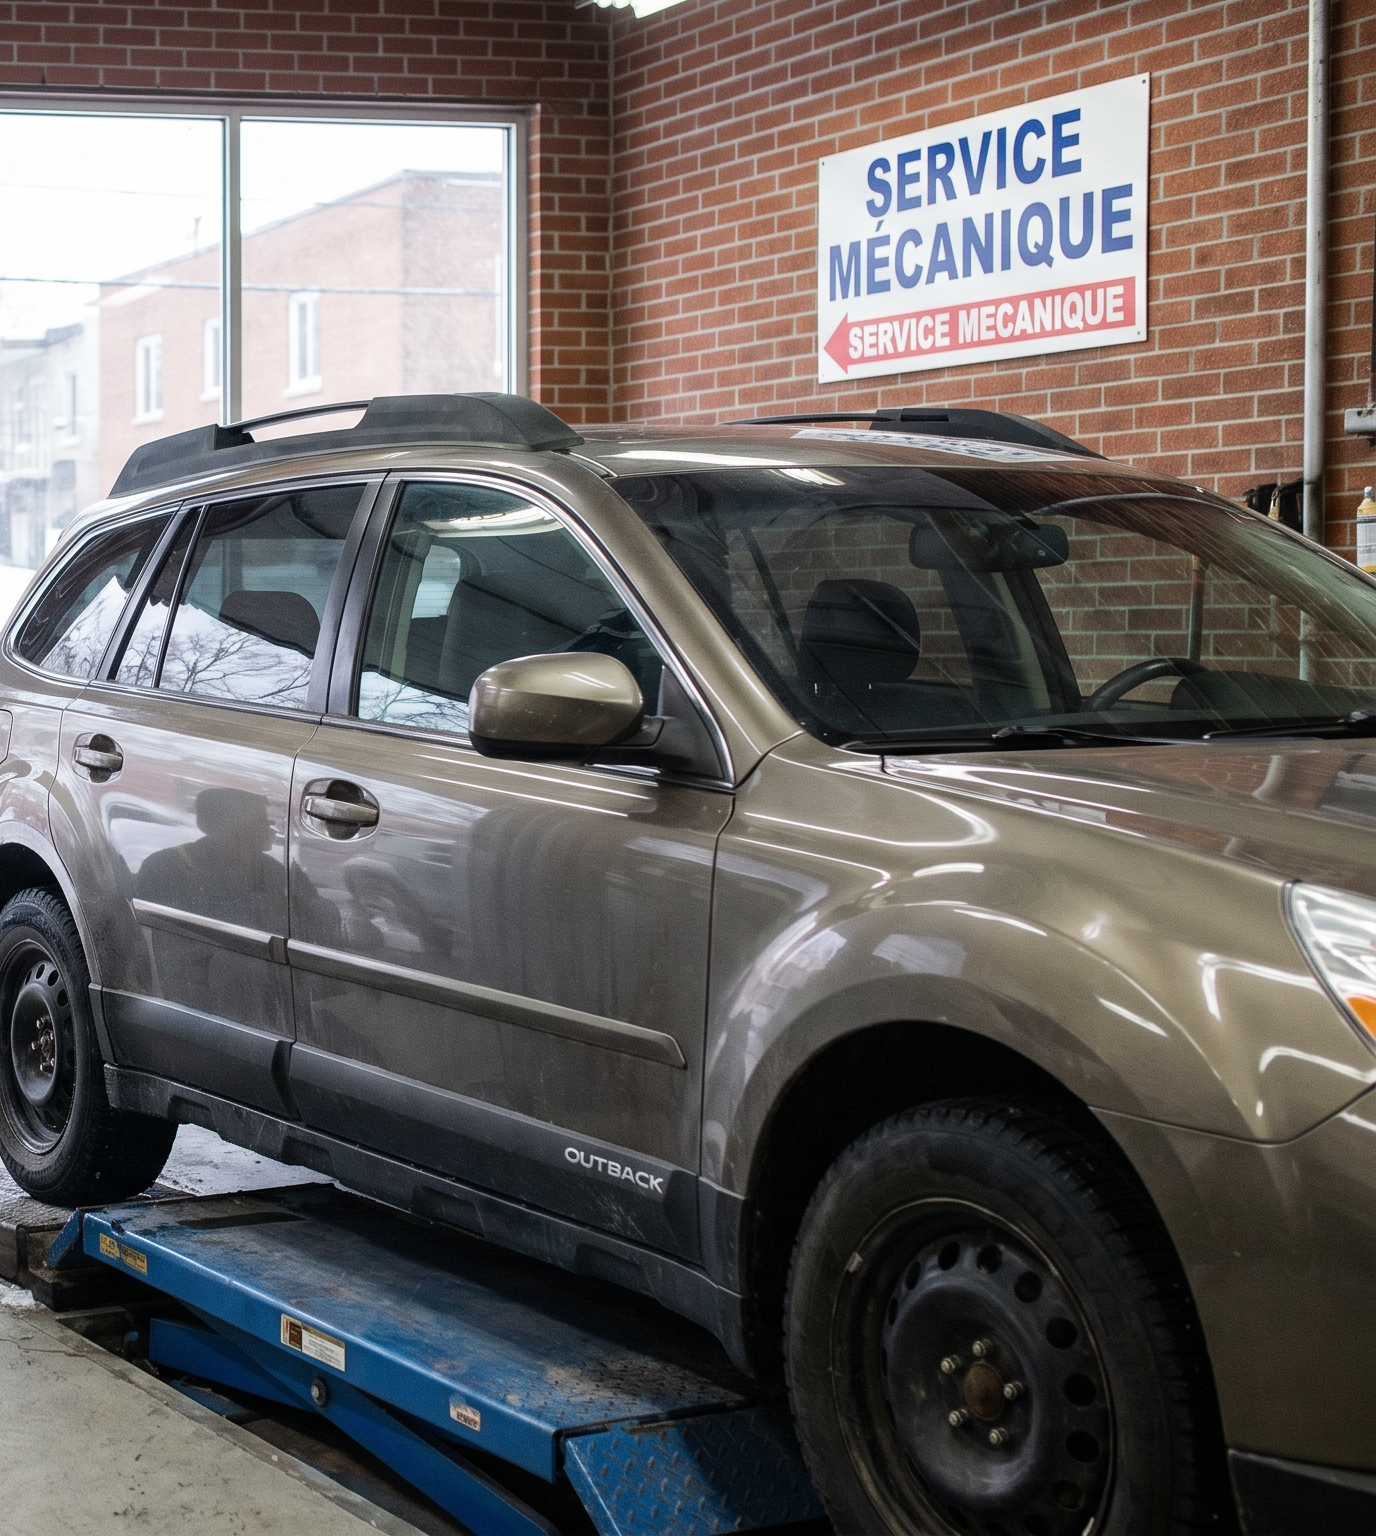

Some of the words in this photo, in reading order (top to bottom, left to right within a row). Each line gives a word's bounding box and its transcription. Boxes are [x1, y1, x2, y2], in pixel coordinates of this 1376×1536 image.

[866, 108, 1082, 218] SERVICE
[829, 183, 1133, 302] MÉCANIQUE
[848, 313, 951, 360] SERVICE
[958, 285, 1124, 343] MECANIQUE
[564, 1147, 664, 1194] OUTBACK
